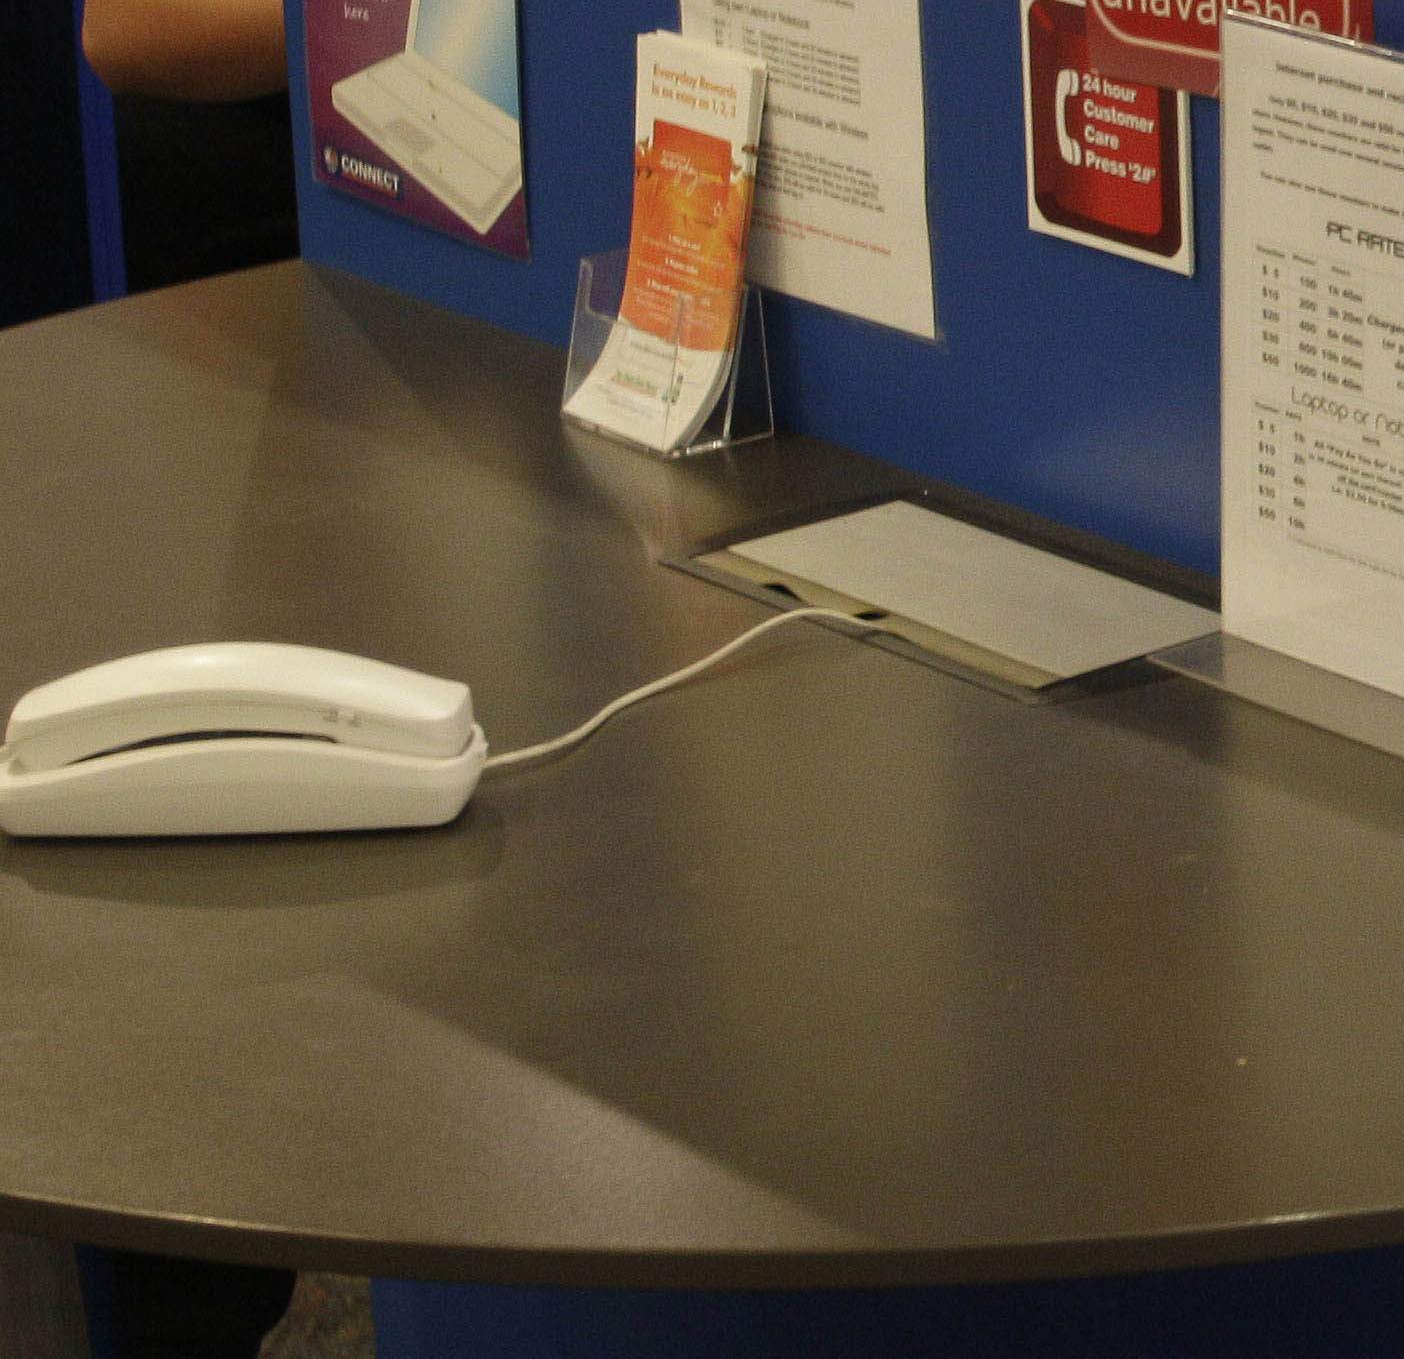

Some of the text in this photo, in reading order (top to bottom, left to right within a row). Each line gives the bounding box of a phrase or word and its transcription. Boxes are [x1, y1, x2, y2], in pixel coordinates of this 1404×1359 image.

[344, 1, 370, 22] here
[1082, 72, 1138, 105] 24 hour
[1083, 97, 1155, 134] Customer
[1084, 124, 1120, 151] Care
[340, 153, 400, 194] CONNECT
[1085, 149, 1128, 179] Press
[1326, 221, 1352, 244] PC
[1292, 385, 1348, 423] Laptop
[1353, 410, 1371, 426] or
